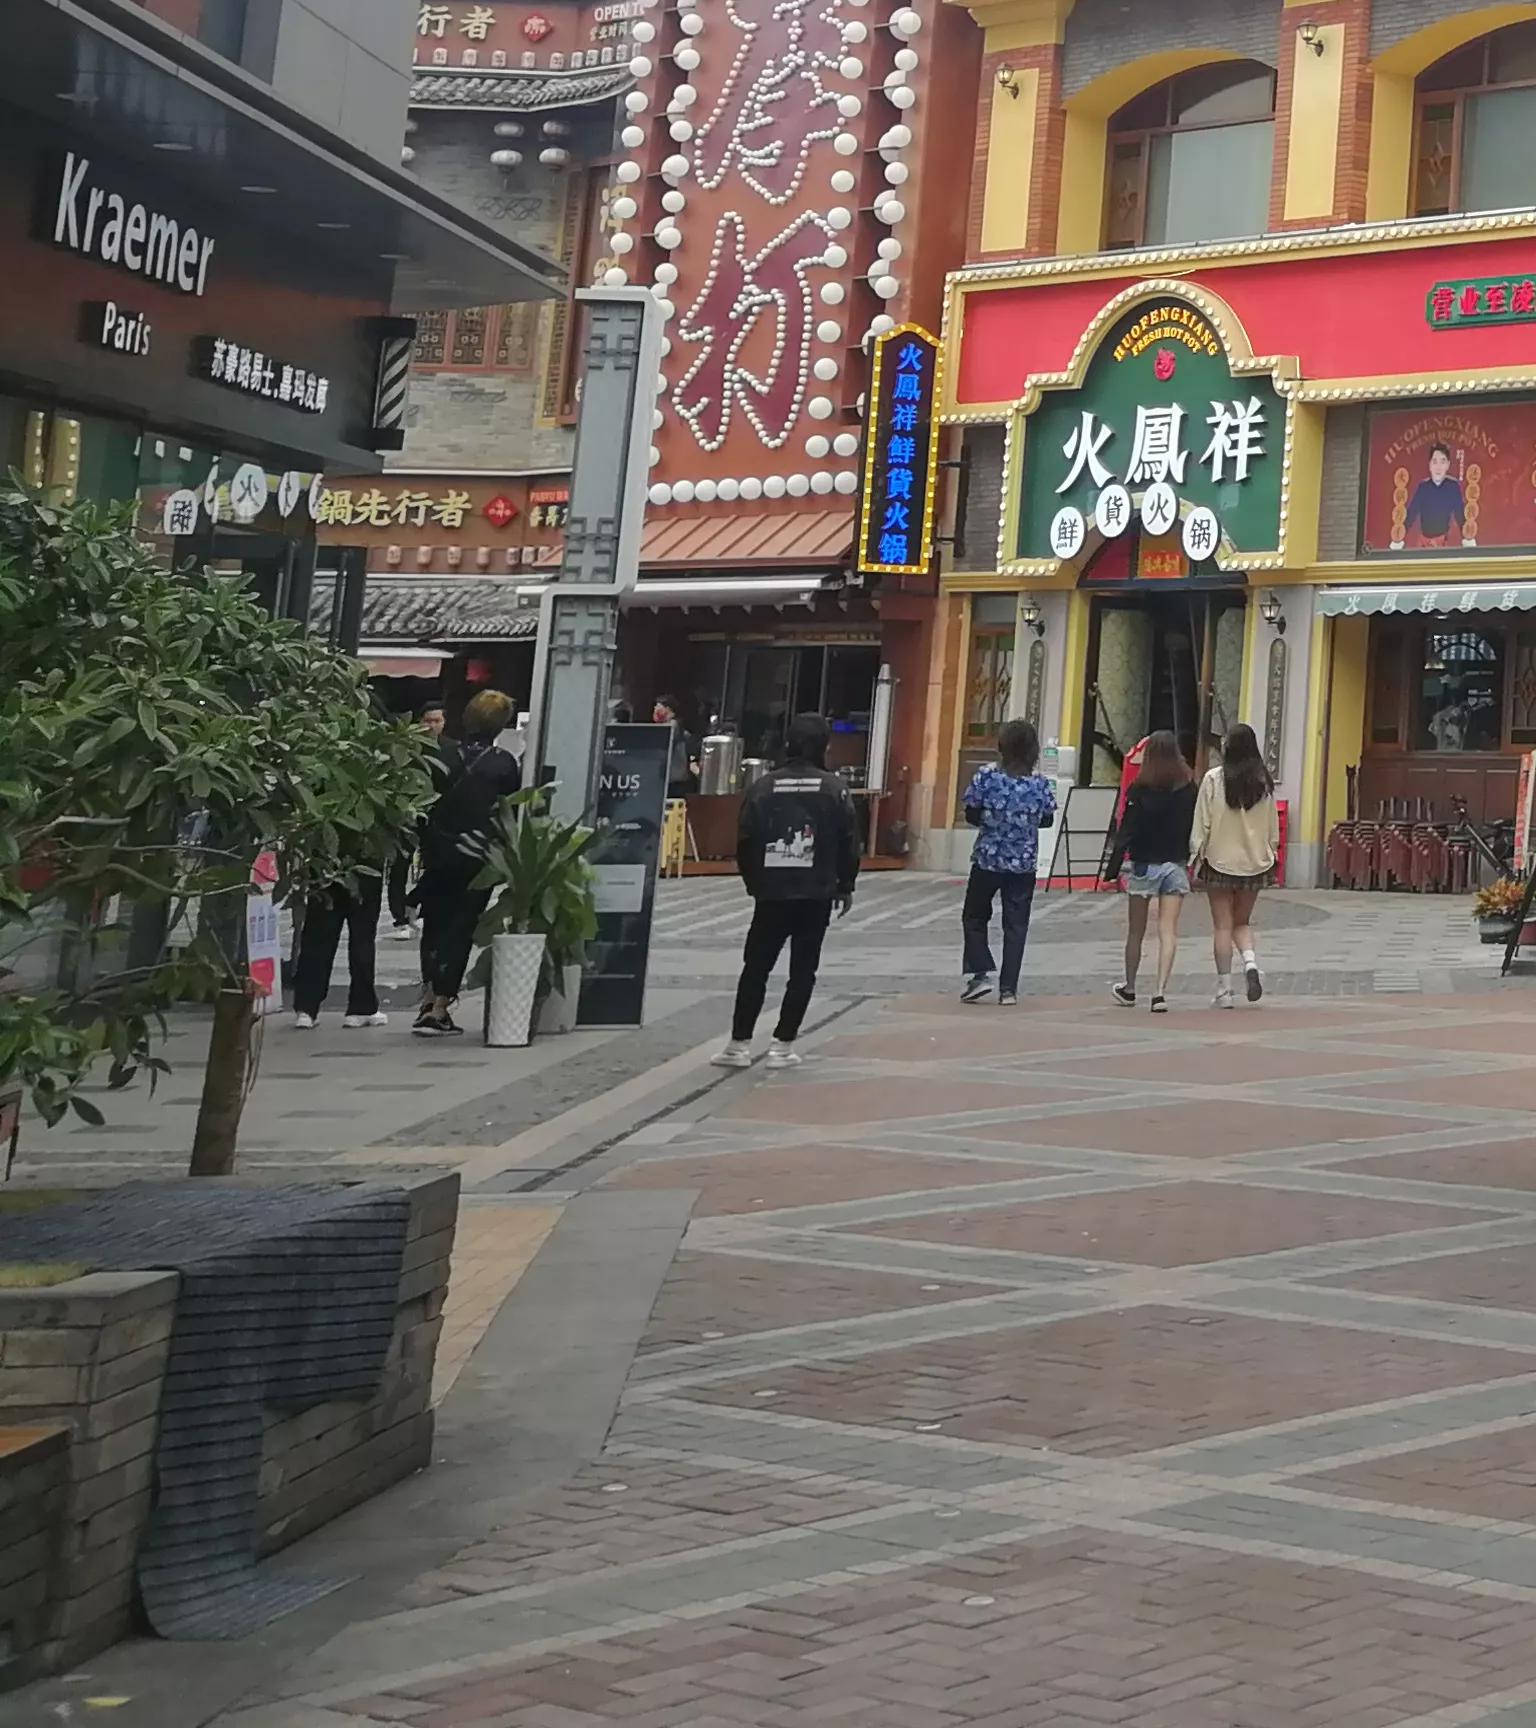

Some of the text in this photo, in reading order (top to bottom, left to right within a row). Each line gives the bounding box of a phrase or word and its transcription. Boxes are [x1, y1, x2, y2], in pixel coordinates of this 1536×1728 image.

[54, 151, 216, 297] Kraemer
[102, 300, 153, 356] Paris
[1113, 306, 1219, 362] HUOFENGXIANG
[1131, 328, 1162, 357] FRESH
[1162, 327, 1184, 340] HOT
[1055, 395, 1268, 494] 火鳳祥
[617, 774, 641, 790] US
